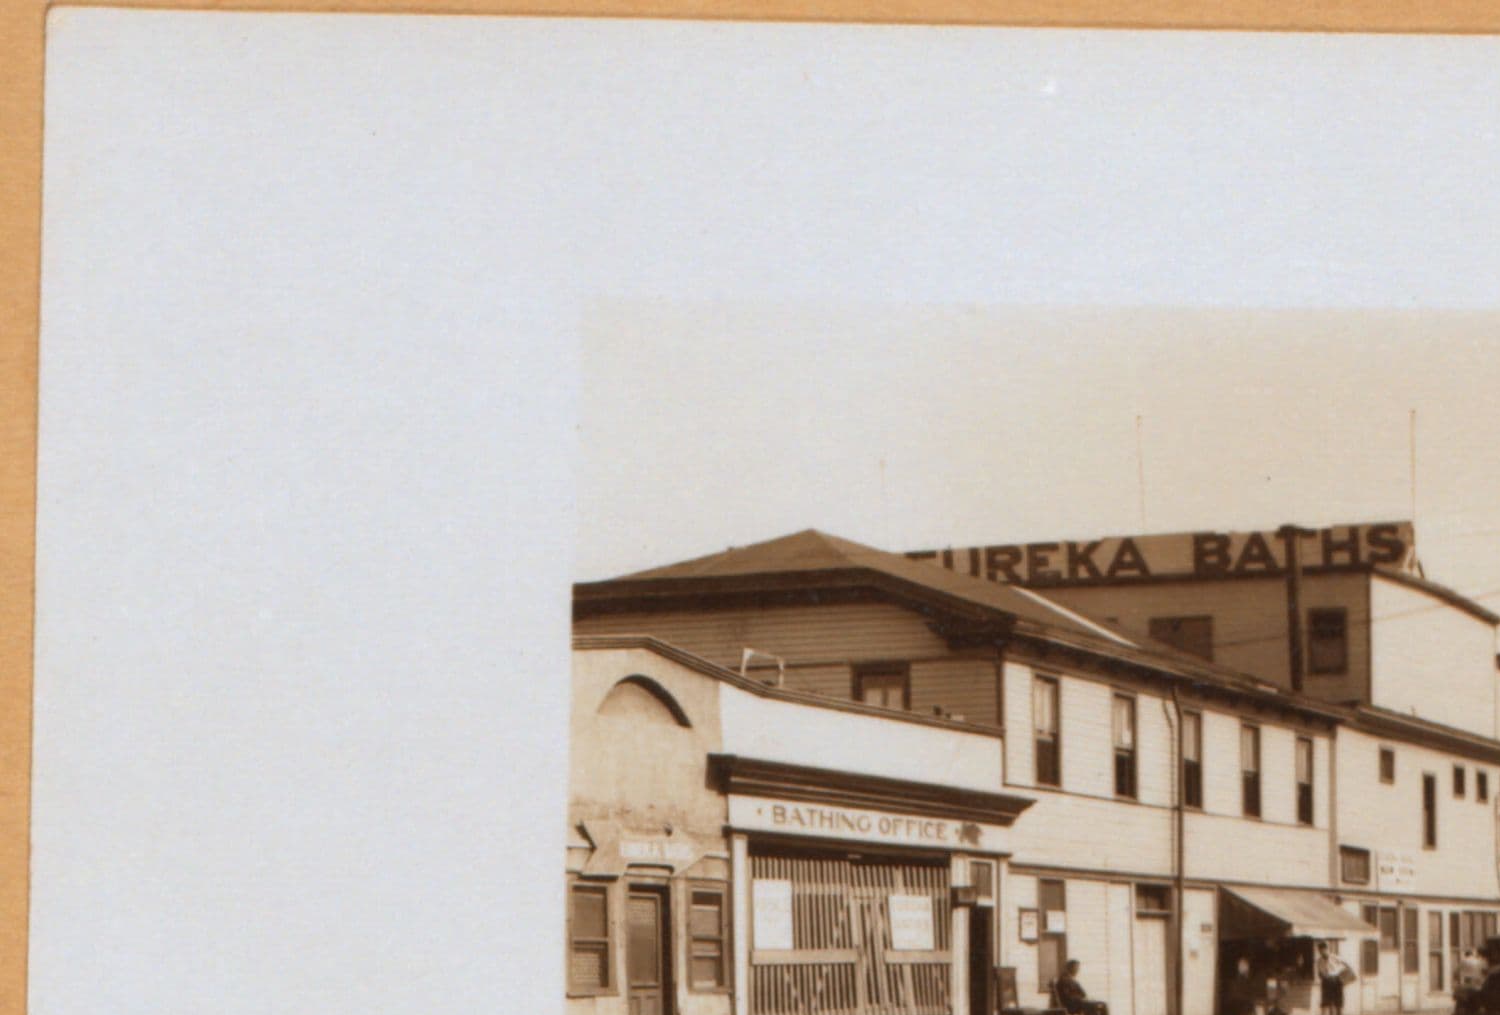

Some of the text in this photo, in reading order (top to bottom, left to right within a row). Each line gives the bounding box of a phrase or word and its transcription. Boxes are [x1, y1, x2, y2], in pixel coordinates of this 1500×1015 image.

[905, 523, 1405, 584] UREKA BATHS
[772, 804, 948, 841] BATHING OFFICE
